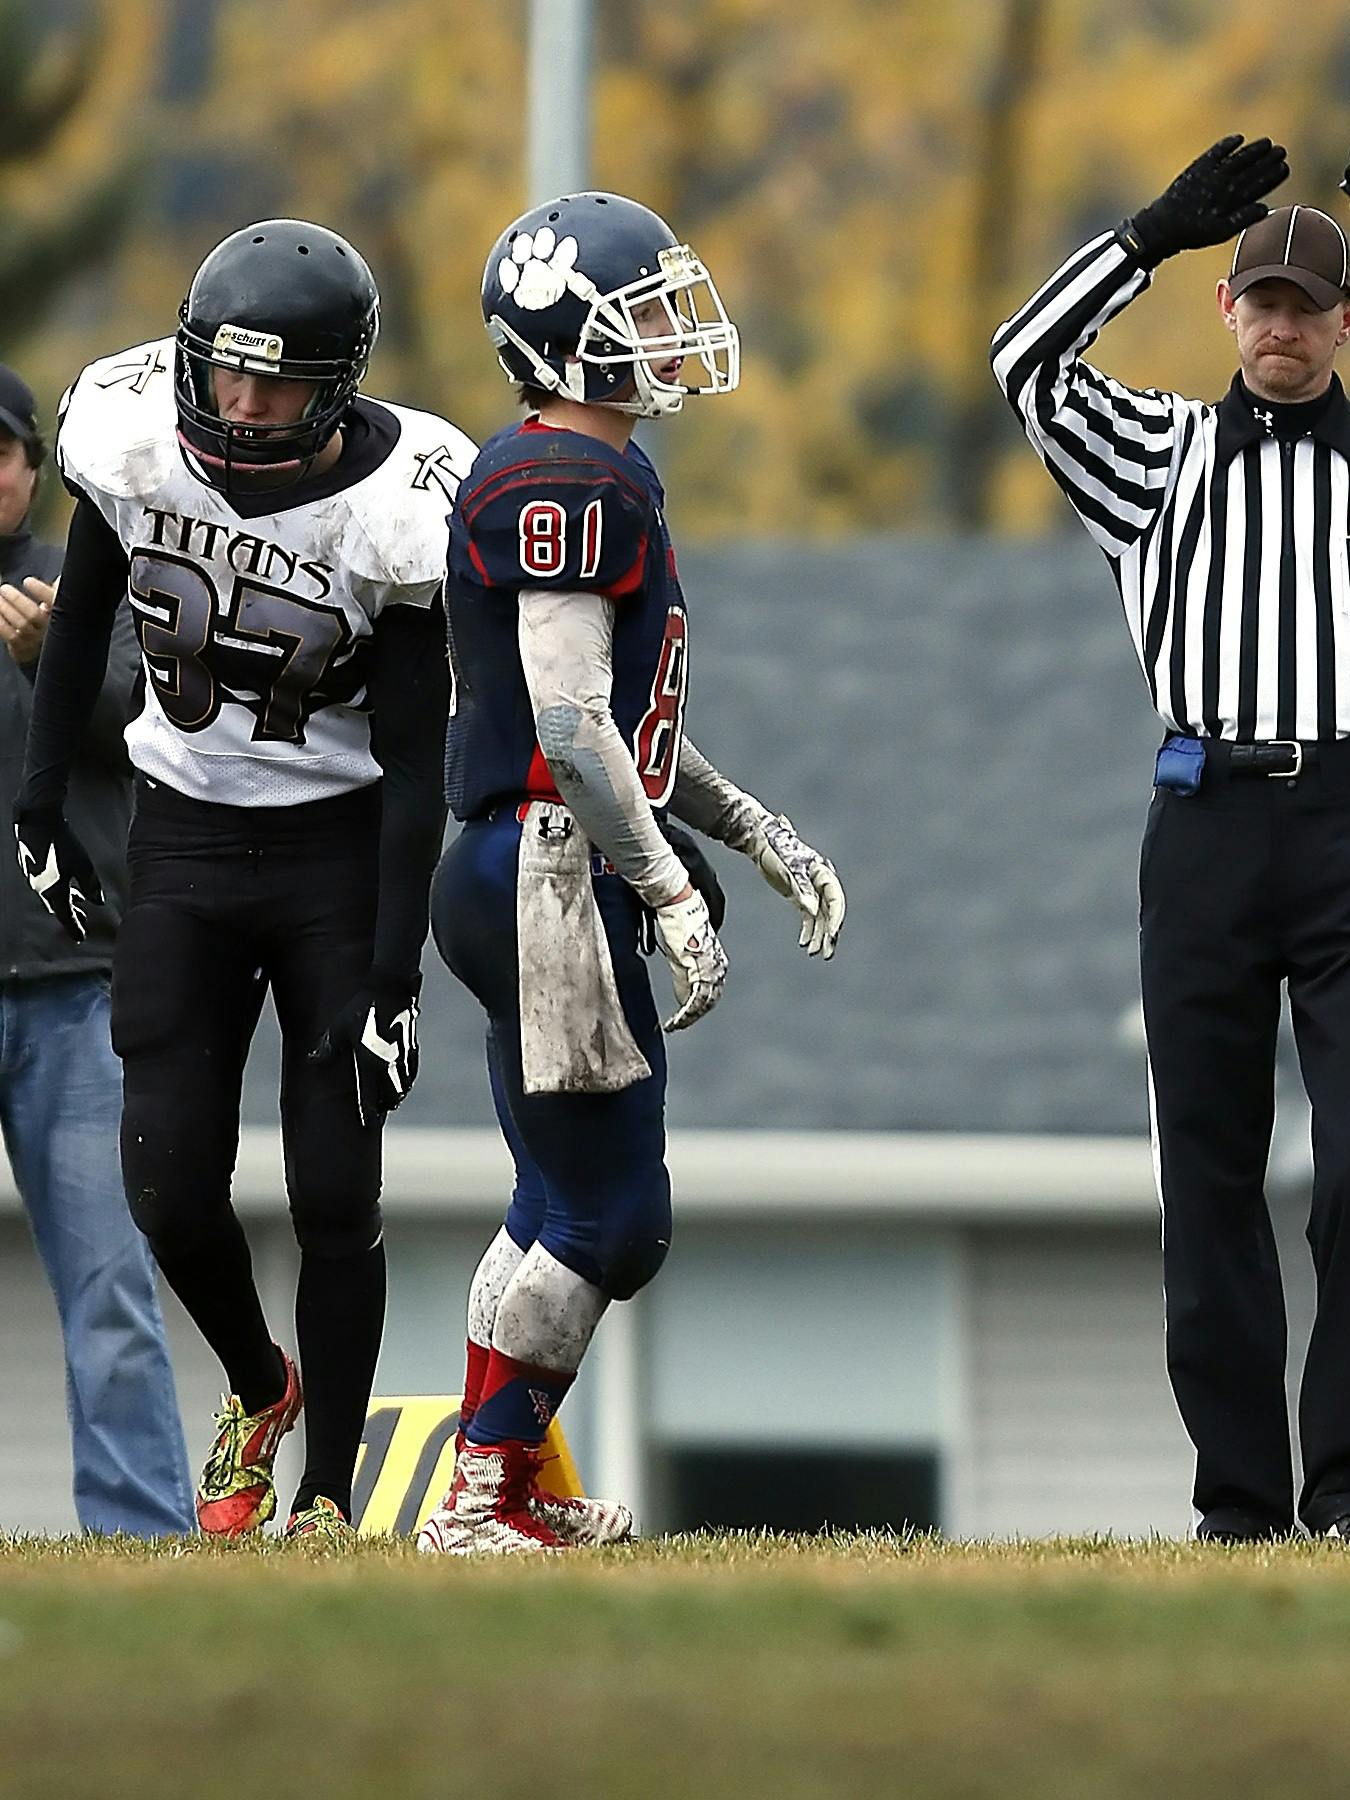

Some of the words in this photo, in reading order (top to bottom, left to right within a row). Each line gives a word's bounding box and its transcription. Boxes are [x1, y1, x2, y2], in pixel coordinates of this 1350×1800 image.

[231, 332, 267, 347] schutt
[143, 505, 335, 600] TITANS
[518, 498, 603, 578] 81
[128, 546, 354, 745] 37
